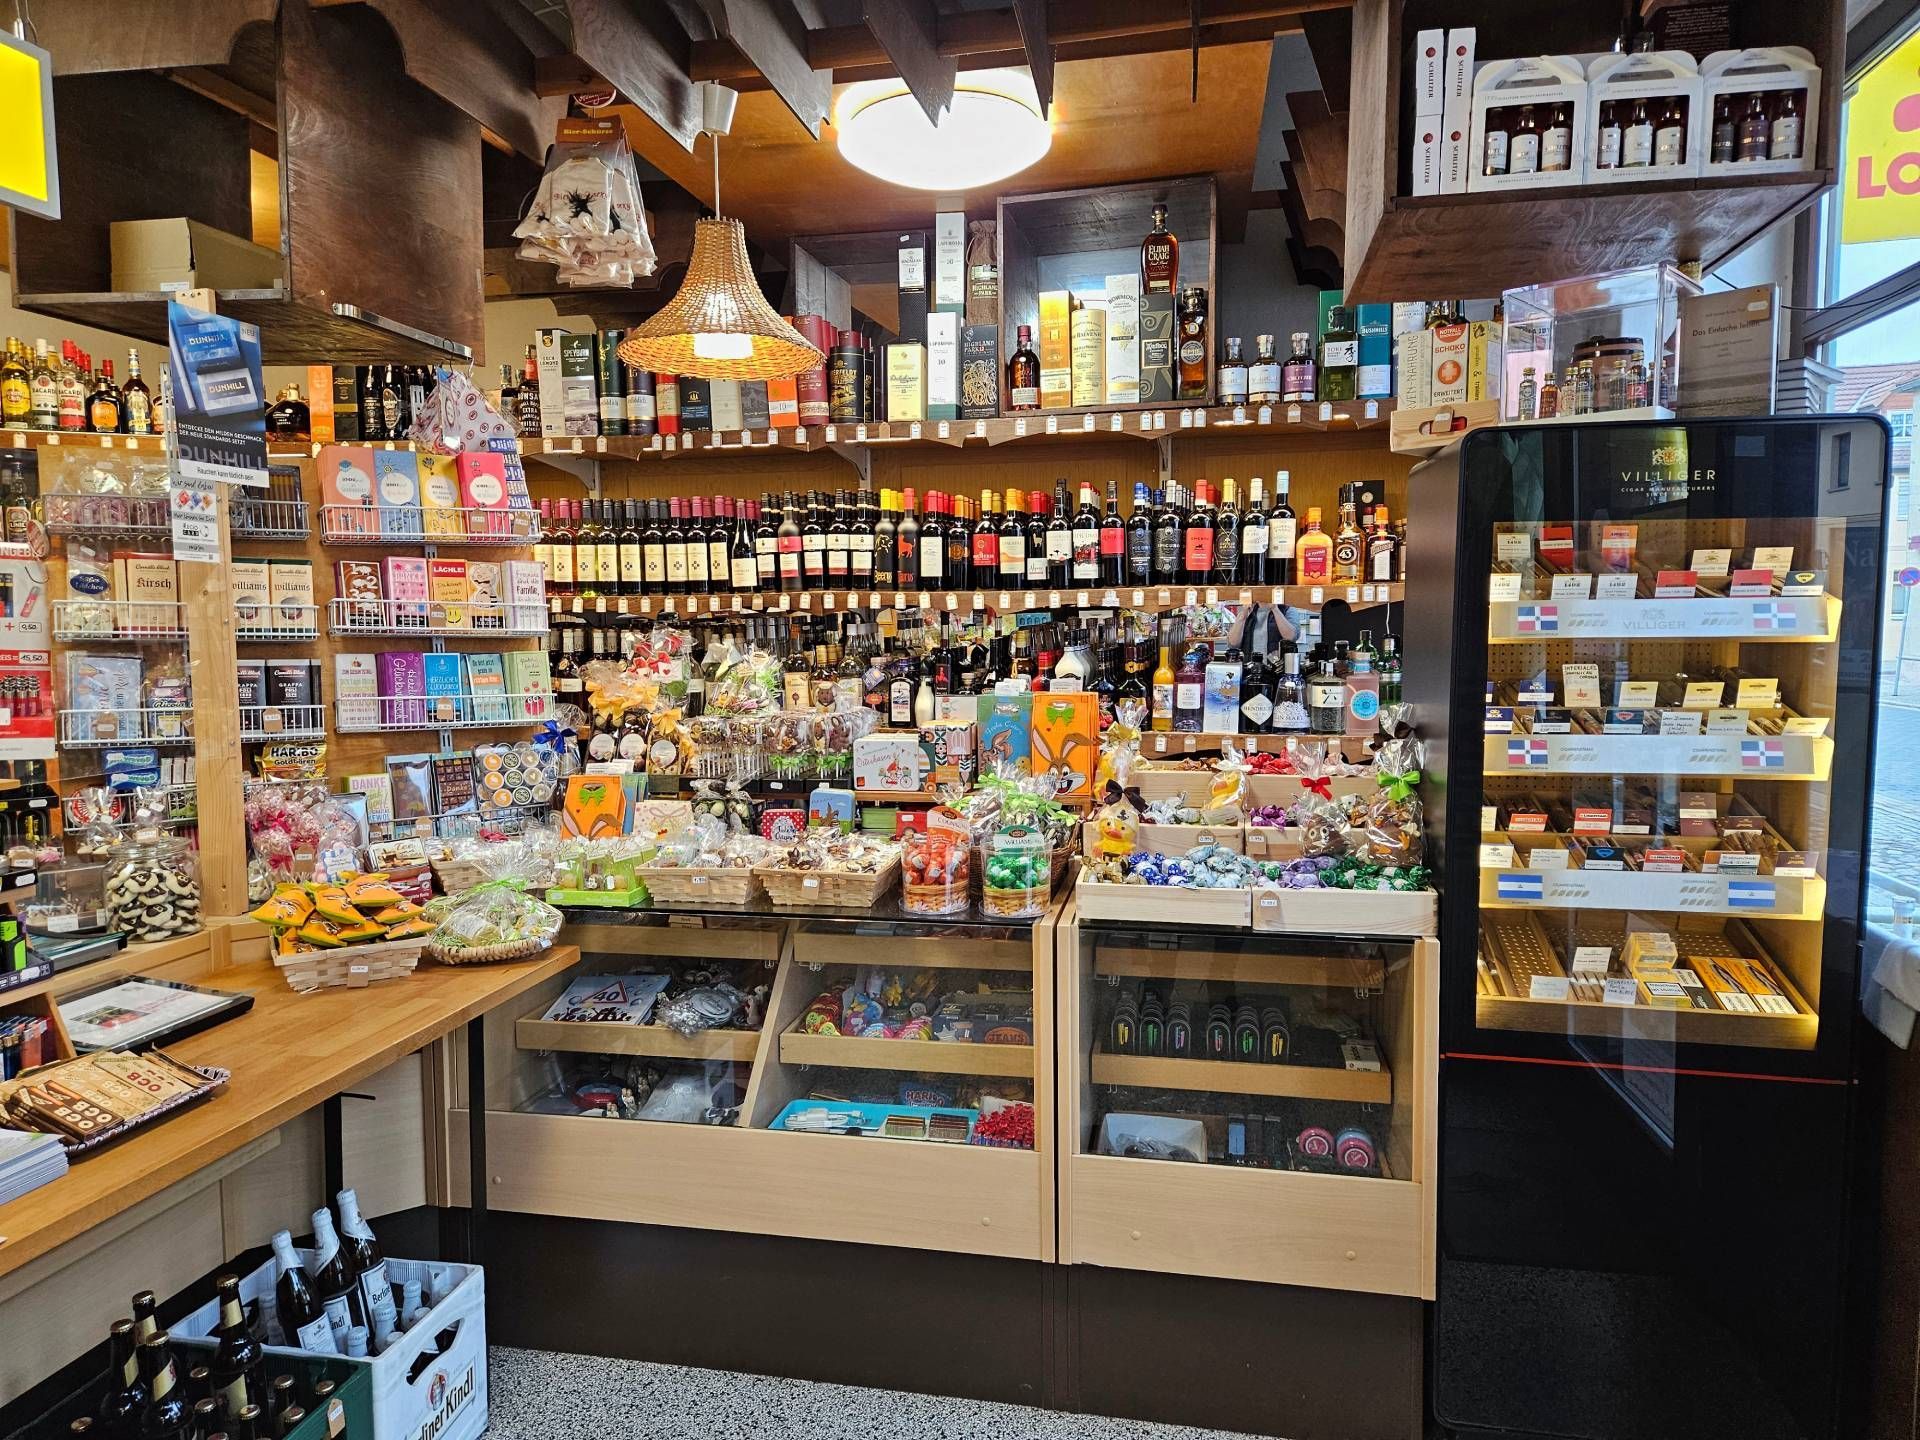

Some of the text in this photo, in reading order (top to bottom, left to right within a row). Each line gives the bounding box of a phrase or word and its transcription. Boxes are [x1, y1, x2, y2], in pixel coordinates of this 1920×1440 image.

[1456, 59, 1464, 97] SCHLITZER
[1451, 144, 1459, 182] SCHLITZER
[1148, 244, 1170, 254] ELIJAH
[1148, 252, 1170, 261] CRAIG
[563, 349, 590, 357] SPEYBURN
[1434, 344, 1465, 353] SCHOKO
[600, 371, 609, 380] 12
[628, 369, 638, 377] 15
[208, 382, 245, 393] DUNHILL
[178, 423, 203, 433] ENTDECKE
[215, 429, 233, 438] MILDEN
[190, 432, 203, 440] NEUE
[203, 434, 231, 444] STANDARDS
[179, 443, 268, 471] DUNHILL
[1621, 469, 1716, 481] VILLIGER
[1339, 549, 1352, 559] 43
[136, 577, 172, 589] Kirsch
[274, 582, 311, 591] williams
[367, 576, 378, 589] 2
[1622, 621, 1685, 630] VILLIGER
[270, 747, 318, 757] HARIBO
[274, 758, 316, 766] Goldbären
[351, 777, 387, 790] DANKE
[593, 991, 620, 1001] 40
[987, 1034, 1025, 1043] JEANS
[127, 1072, 161, 1092] OCB
[72, 1101, 113, 1123] OCB
[54, 1107, 94, 1129] OCB
[446, 1366, 474, 1419] Kindl
